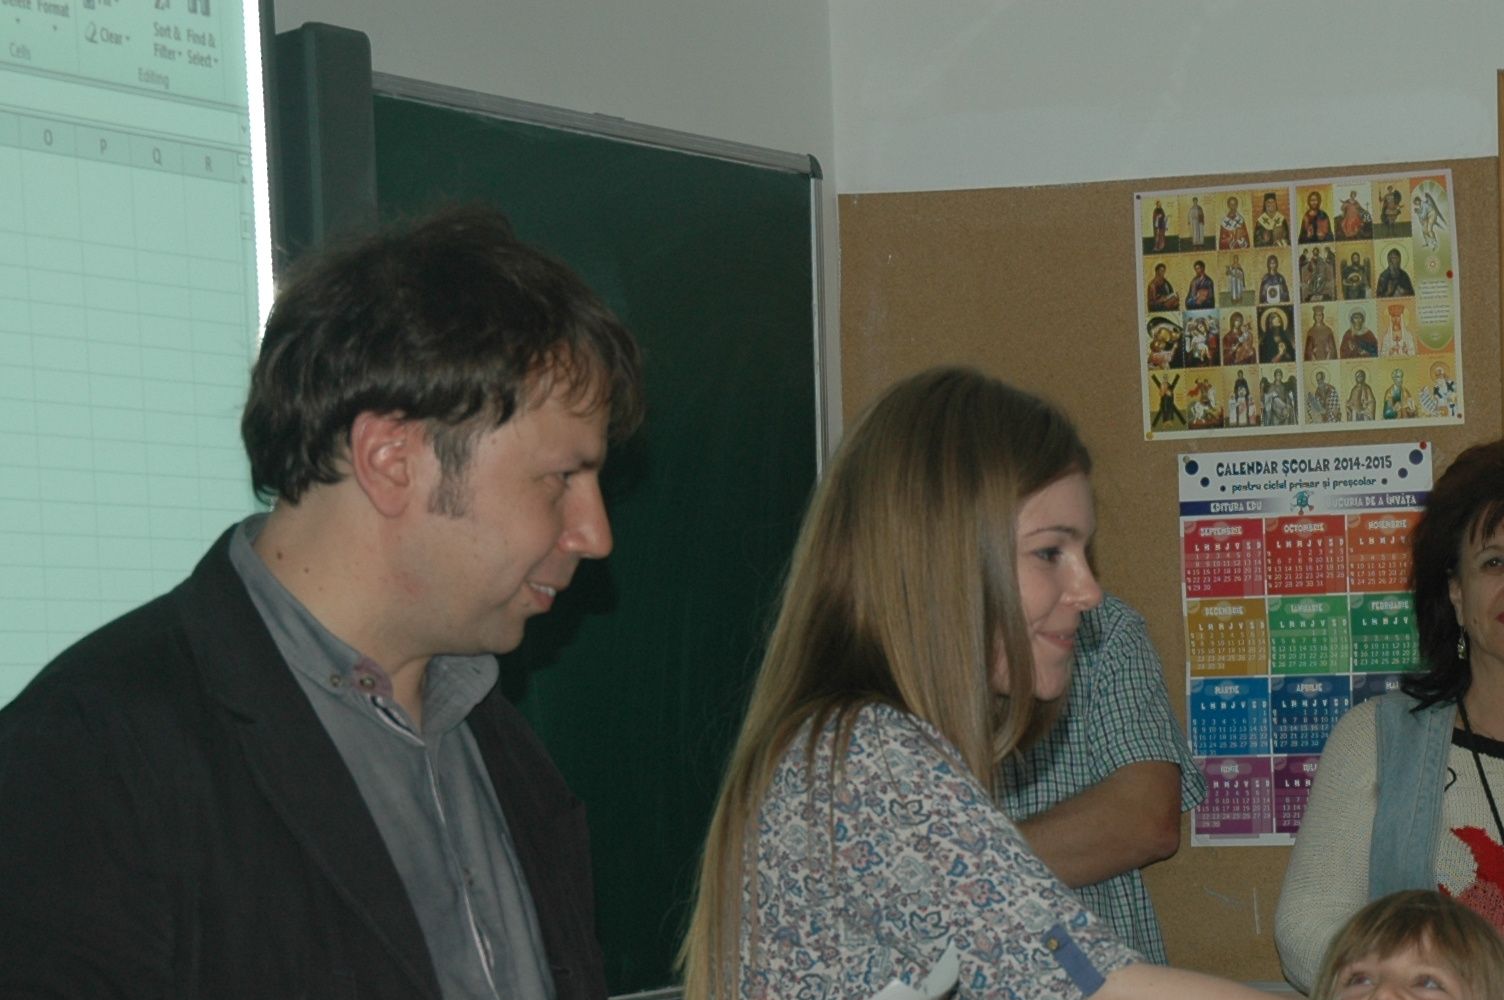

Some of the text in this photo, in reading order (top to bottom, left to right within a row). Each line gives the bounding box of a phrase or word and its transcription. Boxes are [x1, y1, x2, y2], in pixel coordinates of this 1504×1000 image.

[100, 27, 122, 46] Clear
[153, 22, 172, 37] Sort
[187, 28, 206, 45] Find
[153, 43, 213, 67] Filter Select
[138, 67, 169, 89] Editing
[1216, 460, 1278, 477] CALENDAR
[1334, 455, 1392, 471] 2014-2015
[1231, 481, 1261, 494] pentru
